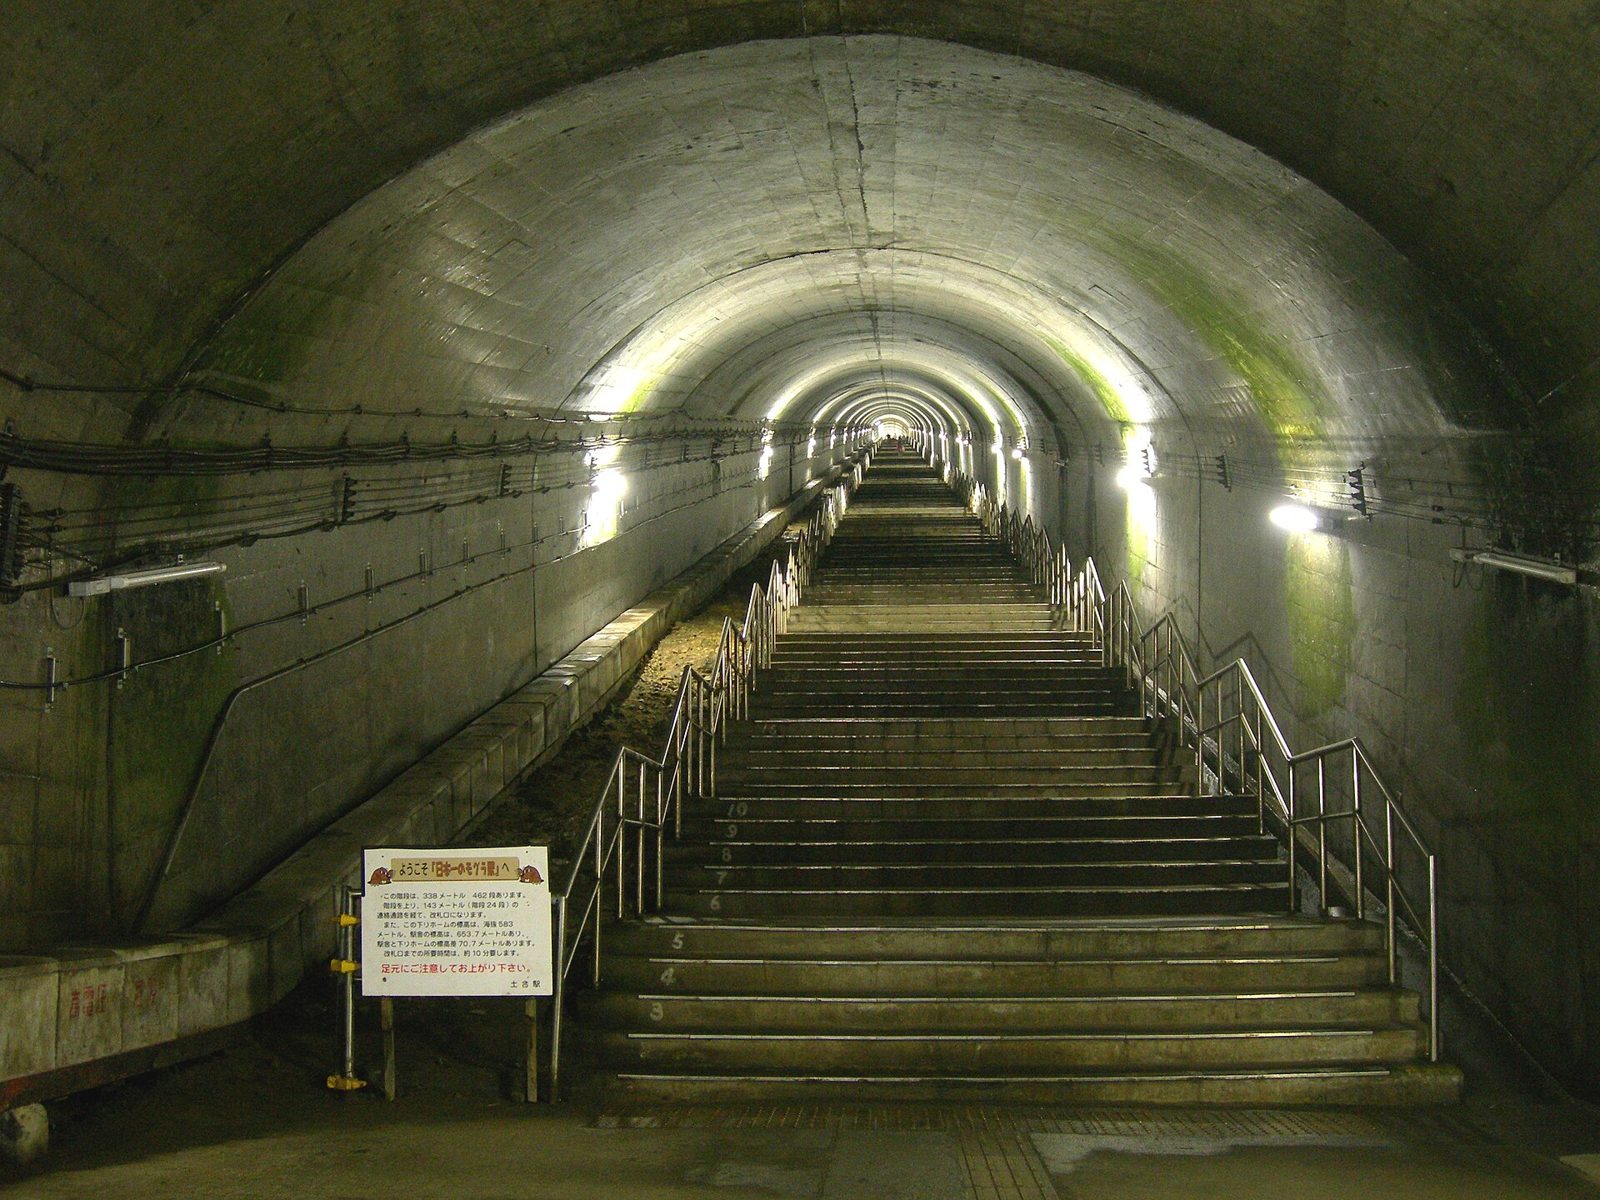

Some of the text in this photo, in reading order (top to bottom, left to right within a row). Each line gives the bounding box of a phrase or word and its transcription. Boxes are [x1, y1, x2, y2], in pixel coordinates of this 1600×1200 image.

[728, 802, 748, 817] 10
[726, 824, 738, 838] 9
[722, 847, 732, 862] 8
[716, 871, 728, 885] 7
[710, 895, 721, 910] 6
[671, 933, 685, 950] 5
[381, 963, 531, 974] 足元にご注意してお上がり下さい。
[660, 967, 676, 986] 4
[649, 1002, 664, 1021] 3
